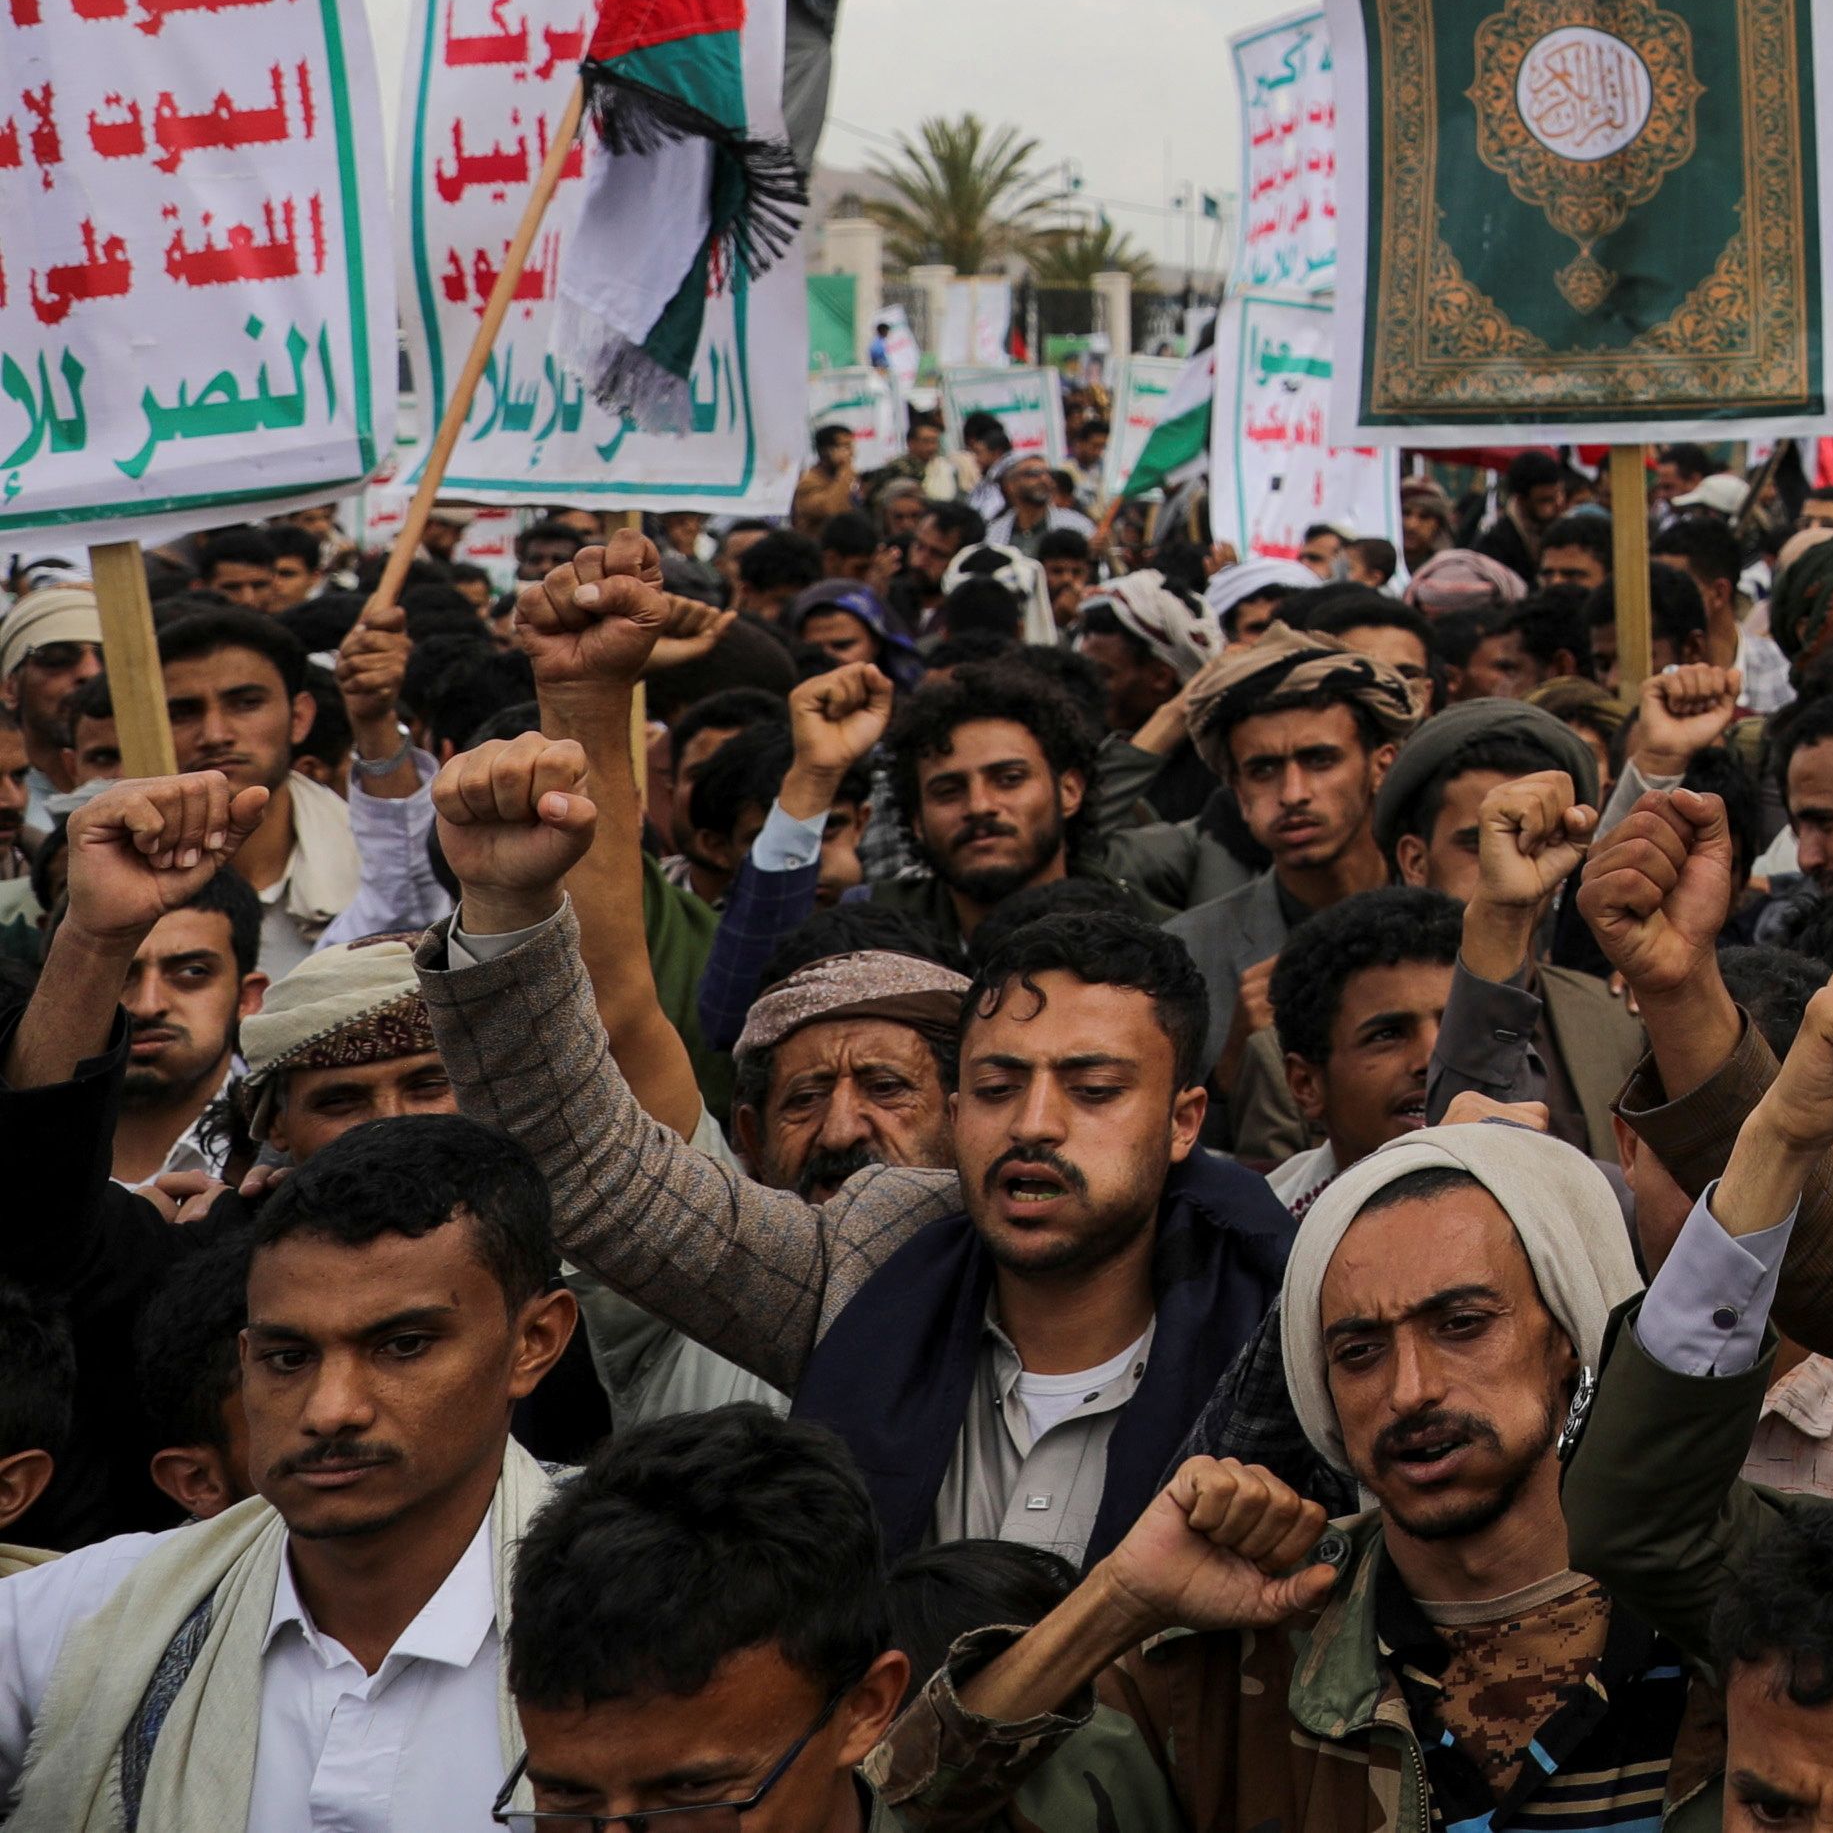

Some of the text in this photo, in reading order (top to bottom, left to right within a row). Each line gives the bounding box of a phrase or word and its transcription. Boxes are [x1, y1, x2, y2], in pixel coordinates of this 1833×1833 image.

[86, 59, 315, 174] الموت
[30, 216, 133, 326] على
[161, 191, 326, 287] اللعنة
[113, 313, 338, 480] النصر
